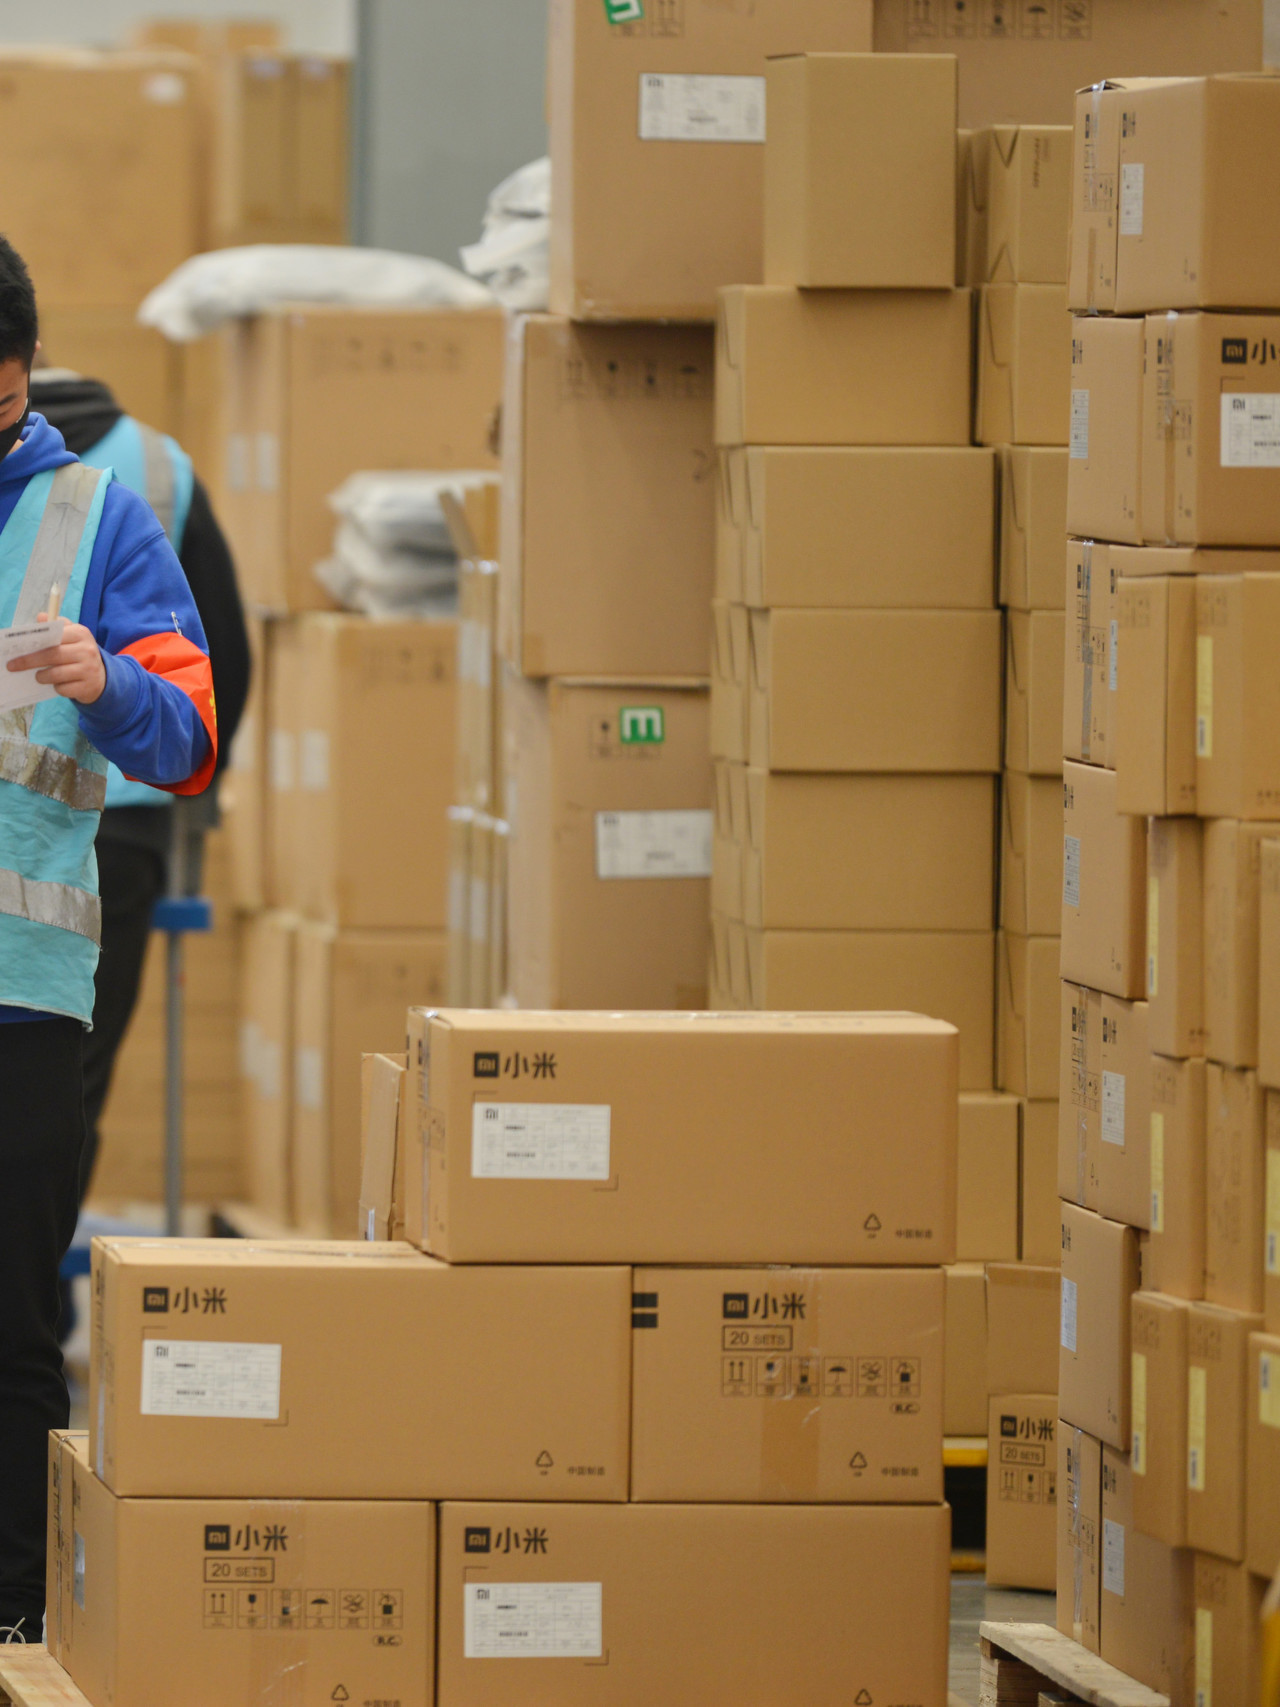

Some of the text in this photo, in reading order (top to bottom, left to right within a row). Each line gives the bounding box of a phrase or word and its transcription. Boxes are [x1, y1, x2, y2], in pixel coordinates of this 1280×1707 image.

[504, 1053, 557, 1079] 小米
[173, 1287, 227, 1314] 小米
[753, 1292, 806, 1319] 小米
[730, 1331, 785, 1345] 20 SETS
[1020, 1417, 1054, 1441] 小米
[235, 1525, 288, 1551] 小米
[495, 1527, 549, 1554] 小米
[211, 1563, 268, 1577] 20 SETS
